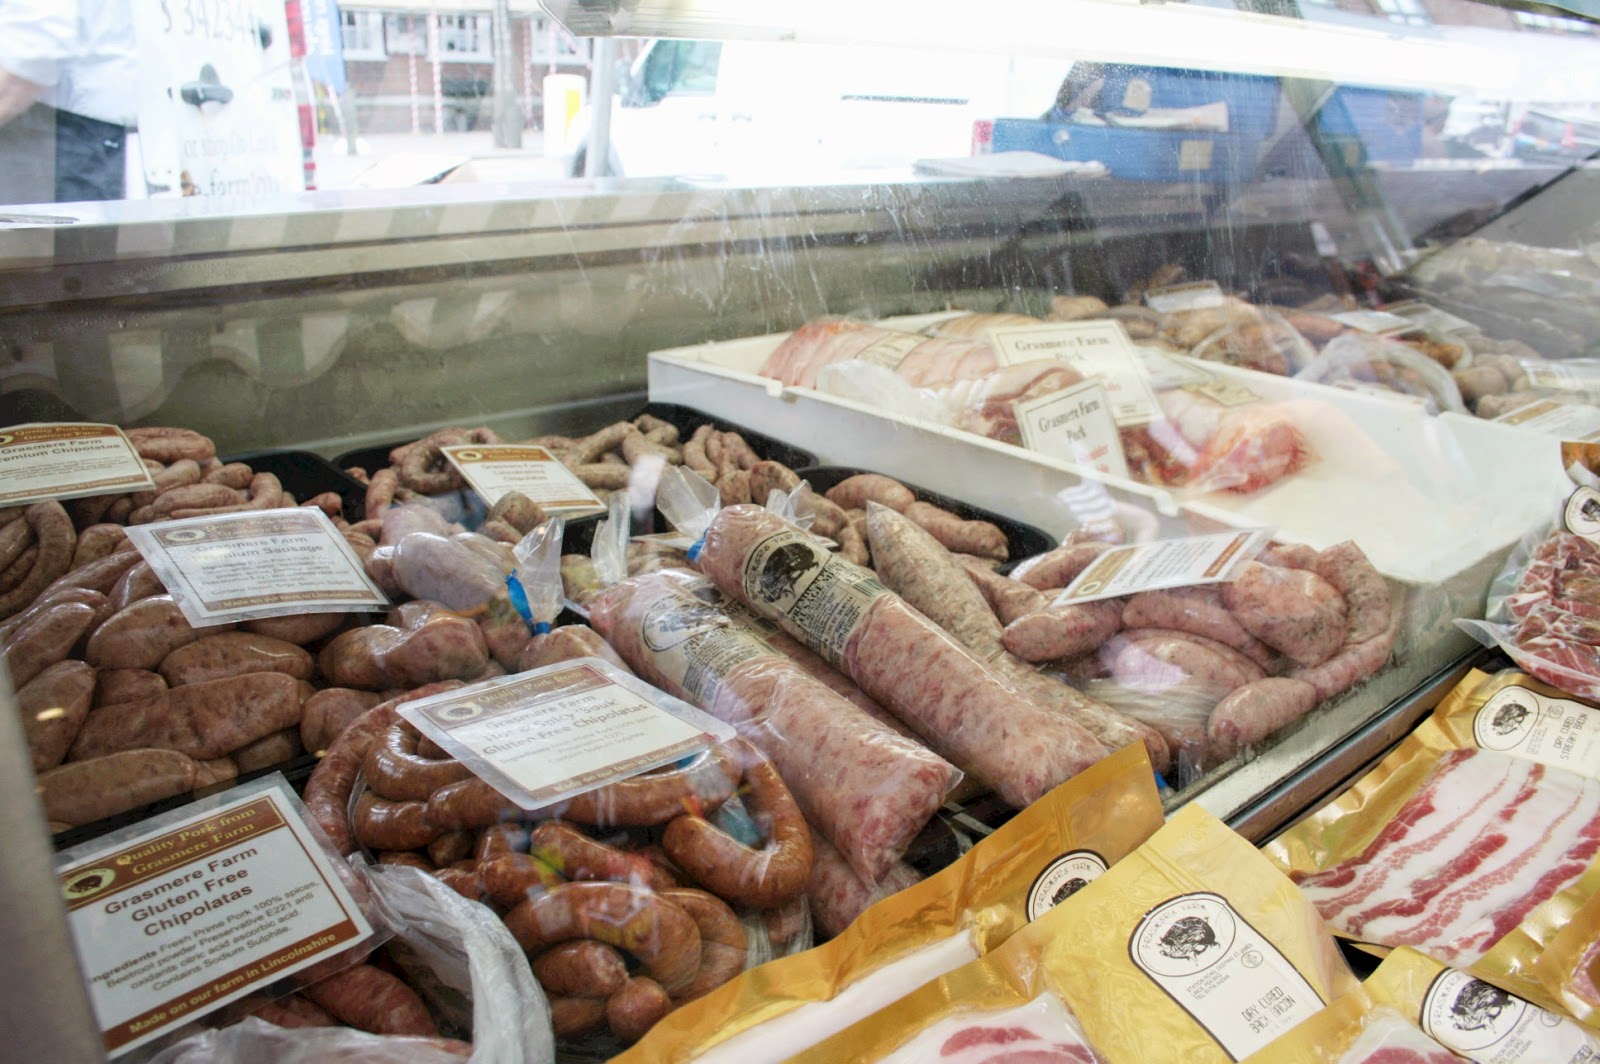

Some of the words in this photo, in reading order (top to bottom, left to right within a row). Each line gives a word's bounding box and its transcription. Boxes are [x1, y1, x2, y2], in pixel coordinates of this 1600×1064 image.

[1076, 336, 1109, 345] Farm
[1039, 409, 1080, 432] Grasmere
[1080, 400, 1100, 416] Farm
[0, 450, 48, 462] remium
[52, 443, 120, 455] Chipolatas
[1, 442, 66, 455] Grasmere
[262, 543, 324, 555] Sausage
[271, 536, 308, 545] Farm
[223, 598, 249, 608] Made
[311, 591, 362, 600] Lincolnshire
[482, 736, 536, 756] Gluten
[539, 727, 571, 740] Free
[572, 703, 648, 728] Chipolatas
[486, 706, 557, 730] Grasmere
[559, 695, 596, 710] Farm
[534, 713, 575, 731] Spicy
[1553, 734, 1562, 749] DRY
[1560, 716, 1575, 734] CURED
[1560, 731, 1578, 760] STREAKY
[1573, 712, 1588, 730] BACON
[116, 838, 176, 866] Quality
[179, 823, 217, 842] Pork
[219, 808, 256, 827] from
[133, 840, 209, 875] Grasmere
[213, 823, 255, 843] Farm
[104, 869, 204, 914] Grasmere
[208, 847, 259, 873] Farm
[1072, 862, 1092, 872] FARM
[132, 888, 200, 922] Gluten
[203, 868, 249, 892] Free
[144, 886, 253, 936] Chipolatas
[92, 950, 158, 983] ngredients
[159, 935, 192, 952] Fresh
[193, 921, 226, 938] Prime
[226, 909, 252, 924] Pork
[253, 896, 284, 911] 100%
[106, 962, 155, 988] Beetroot
[156, 944, 197, 966] powder
[199, 914, 264, 947] Preservative
[265, 902, 293, 917] E221
[294, 891, 315, 906] anti
[131, 964, 178, 990] oxidants
[180, 951, 206, 967] citric
[208, 940, 231, 955] acid
[232, 920, 277, 943] ascorbic
[129, 1012, 167, 1033] Made
[170, 1002, 188, 1016] on
[189, 989, 213, 1005] our
[214, 973, 245, 994] farm
[246, 966, 260, 979] in
[260, 932, 336, 972] Lincolnshire
[152, 965, 203, 992] Contains
[203, 945, 246, 968] Sodium
[1241, 1004, 1259, 1022] DRY
[1258, 986, 1284, 1009] CURED
[1270, 995, 1296, 1017] BACON
